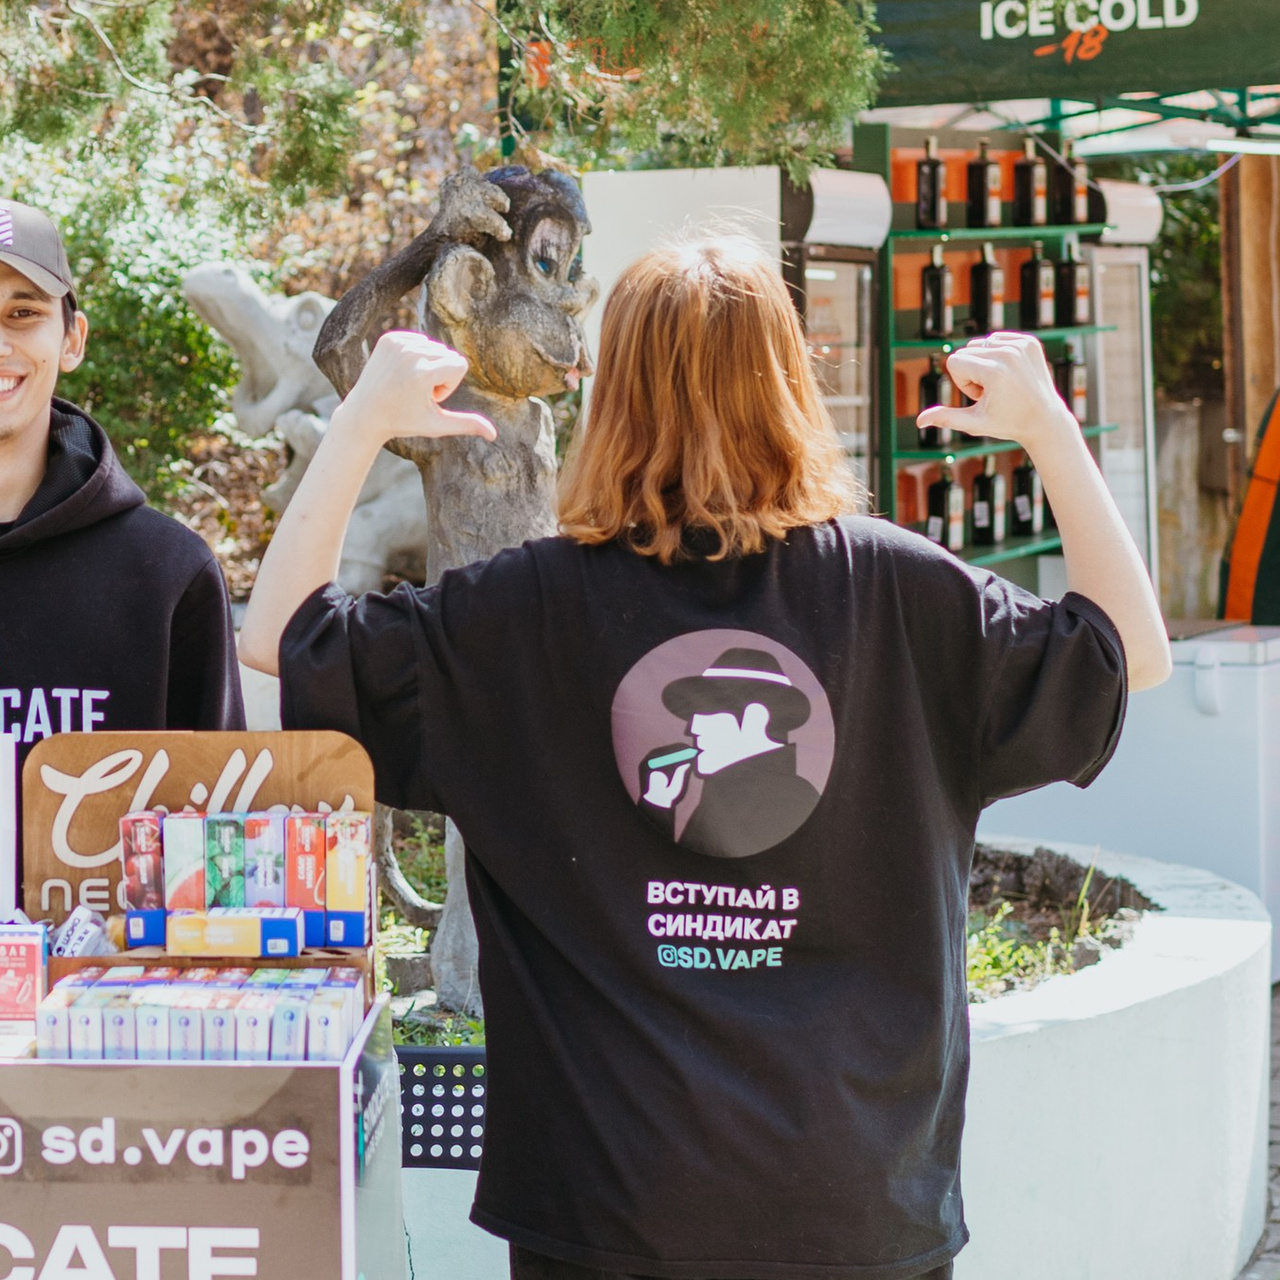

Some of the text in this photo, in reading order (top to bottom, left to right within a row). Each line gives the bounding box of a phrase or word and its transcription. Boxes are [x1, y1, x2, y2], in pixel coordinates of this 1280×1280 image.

[981, 0, 1055, 40] ICE
[1033, 24, 1109, 65] -18
[647, 881, 800, 910] ВСТУПАЙ В
[648, 914, 798, 941] СИНДИКАТ
[42, 1119, 310, 1179] sd.vape
